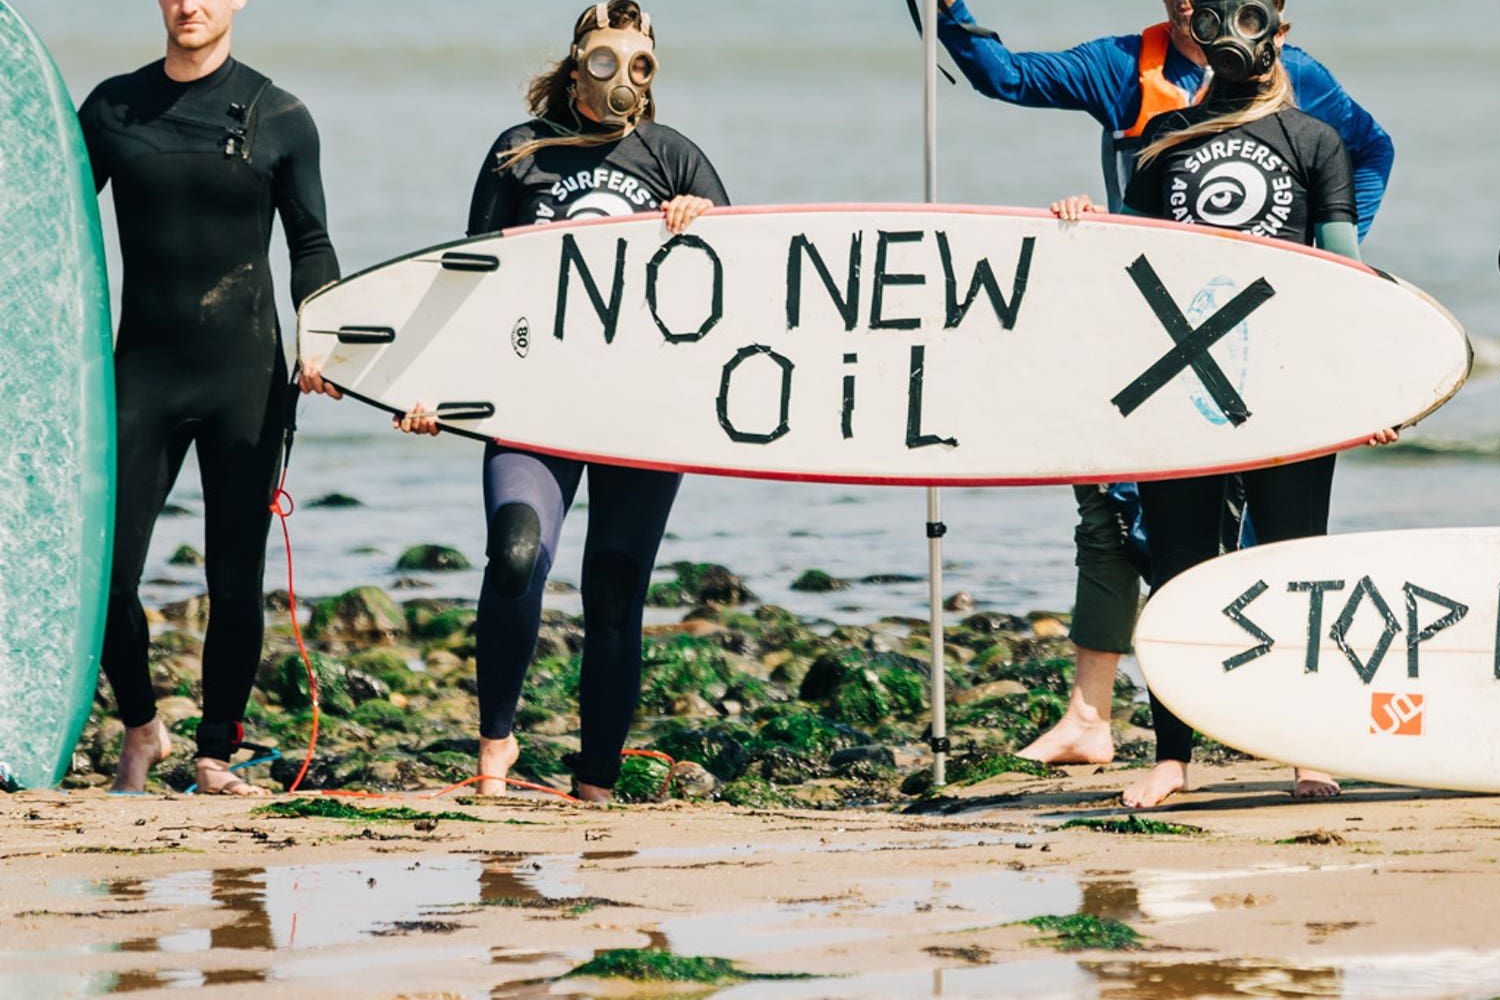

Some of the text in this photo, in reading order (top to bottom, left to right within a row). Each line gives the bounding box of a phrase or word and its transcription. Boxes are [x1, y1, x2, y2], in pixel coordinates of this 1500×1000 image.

[551, 168, 652, 206] SURFERS
[1184, 138, 1282, 174] SURFERS
[553, 229, 1036, 344] NO NEW
[1222, 574, 1469, 685] STOP
